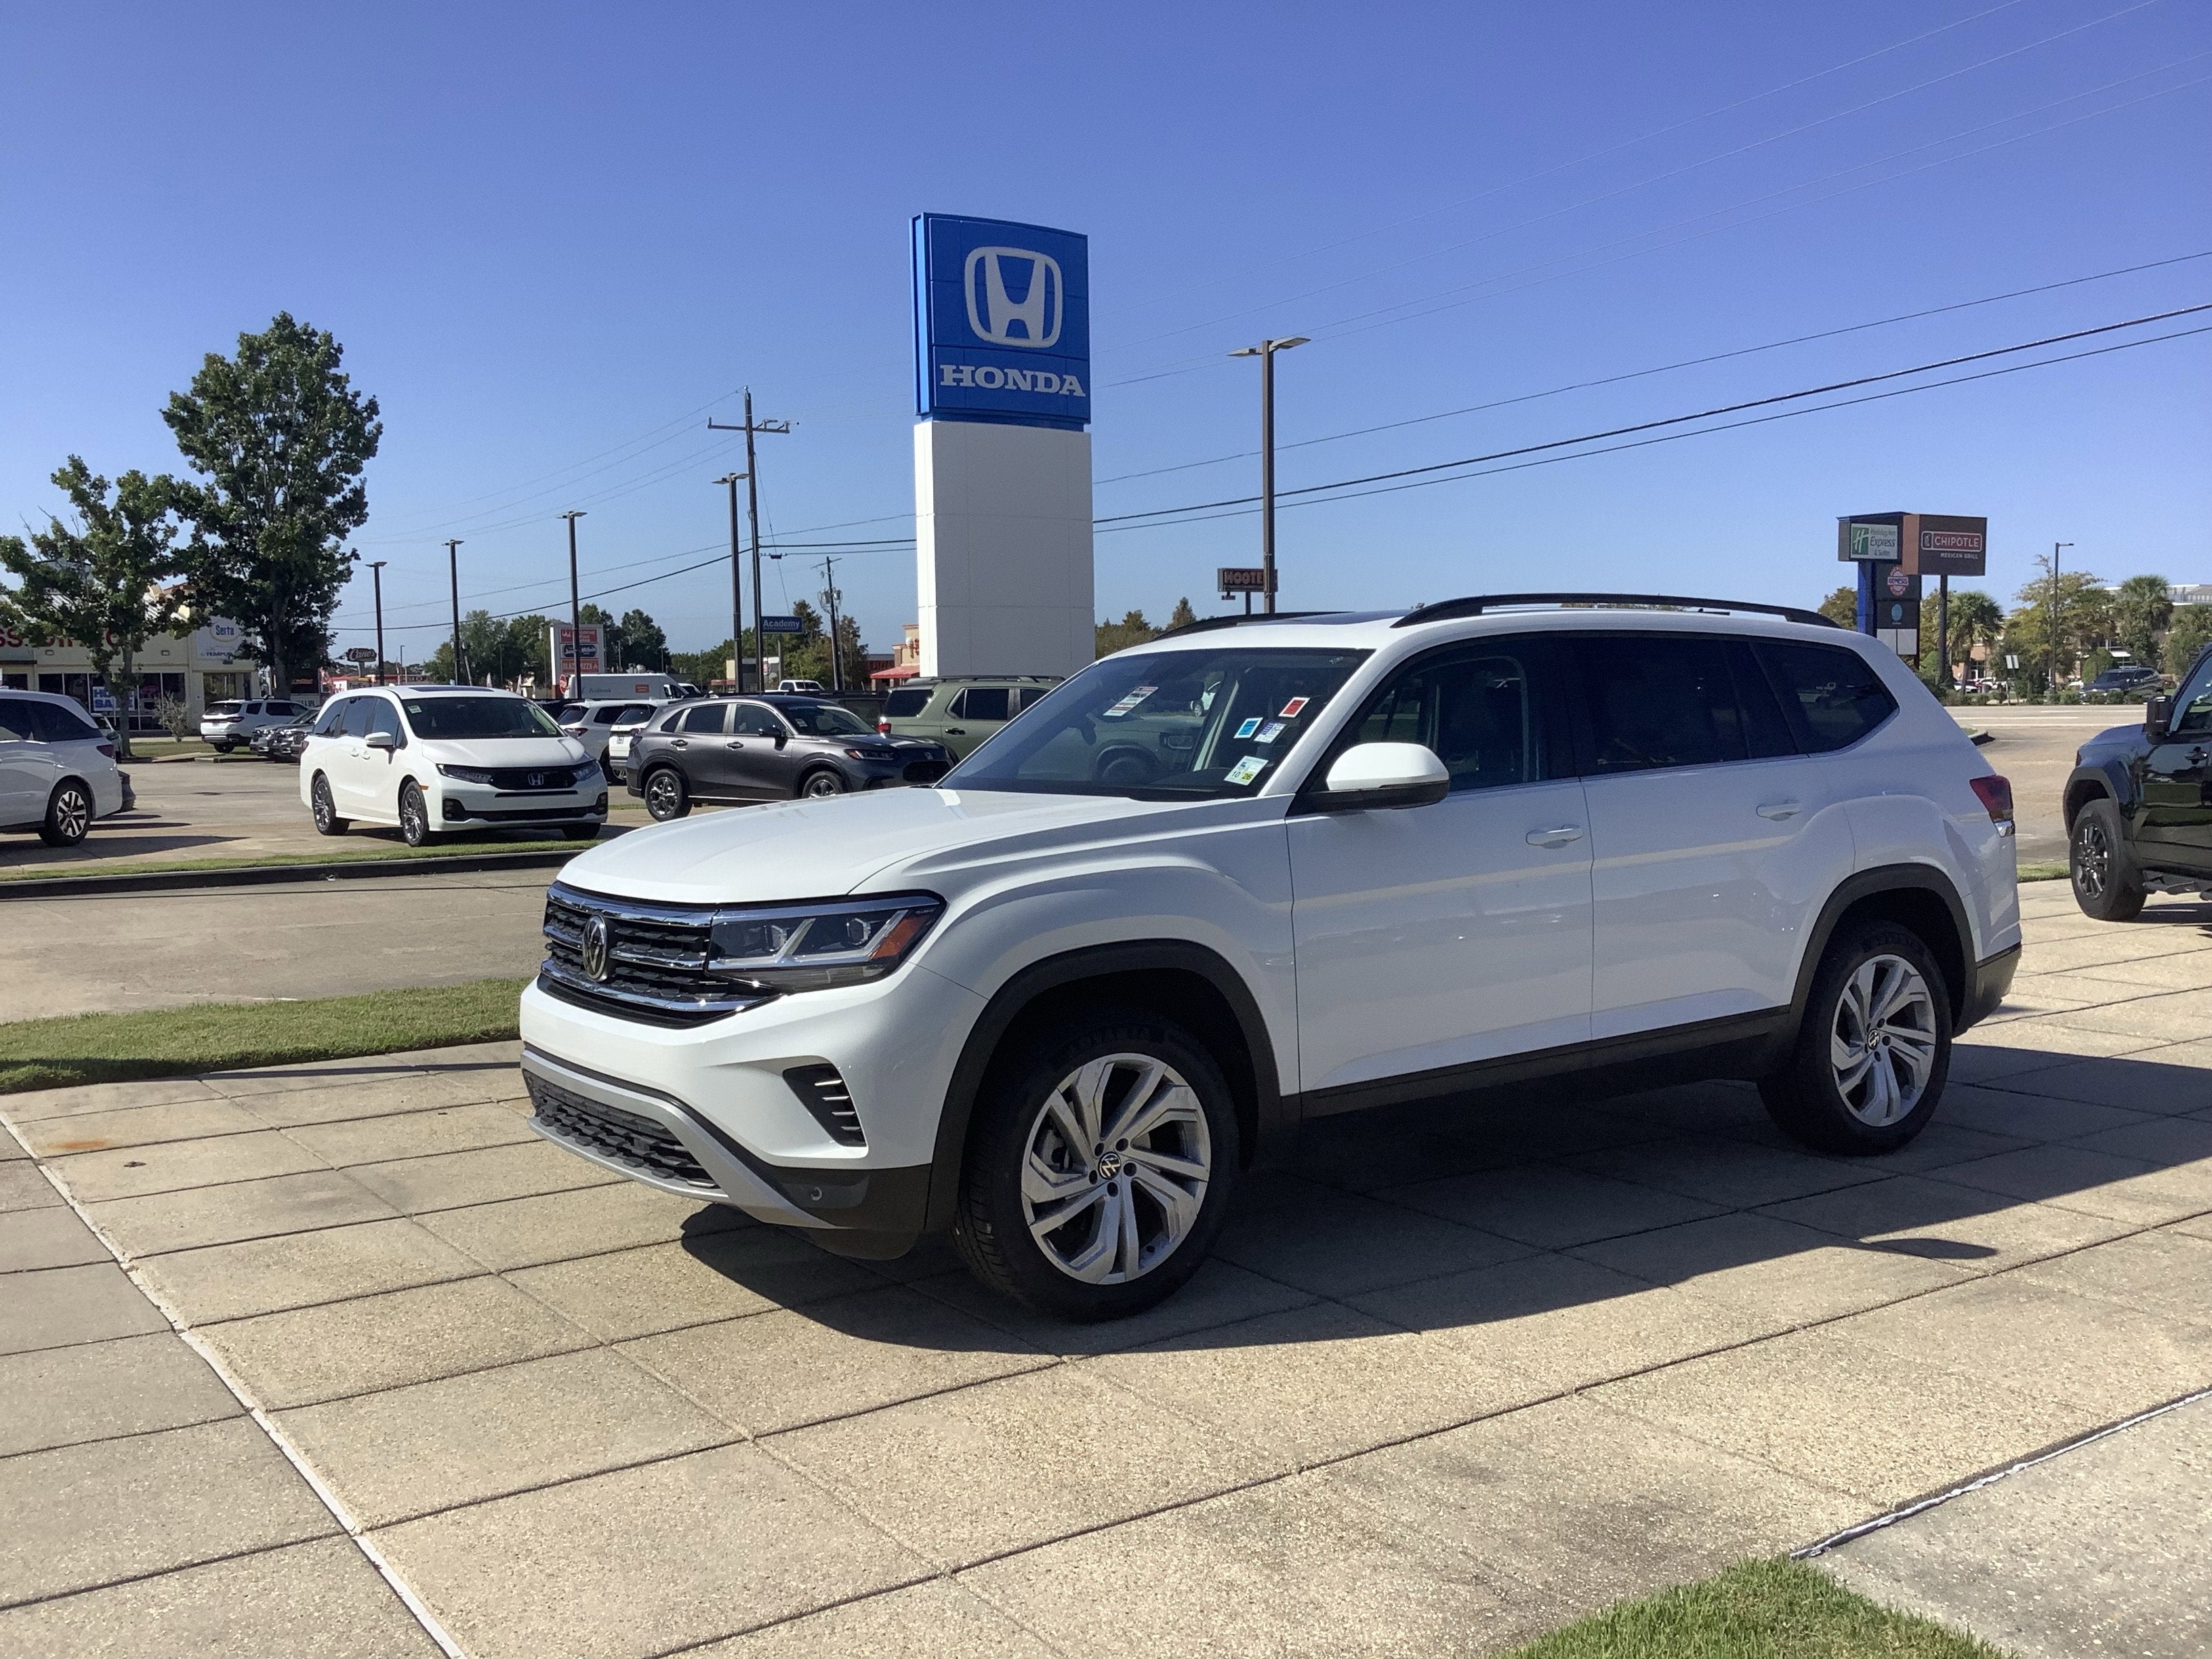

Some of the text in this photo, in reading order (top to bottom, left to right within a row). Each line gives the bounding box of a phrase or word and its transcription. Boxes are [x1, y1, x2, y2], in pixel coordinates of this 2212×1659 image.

[939, 364, 1086, 398] HONDA
[1870, 536, 1896, 549] Express
[1934, 535, 1980, 548] CHIPOTLE
[1224, 571, 1265, 584] HOOTE
[216, 625, 234, 636] Serta
[762, 619, 800, 630] Academy
[1241, 772, 1253, 781] 26
